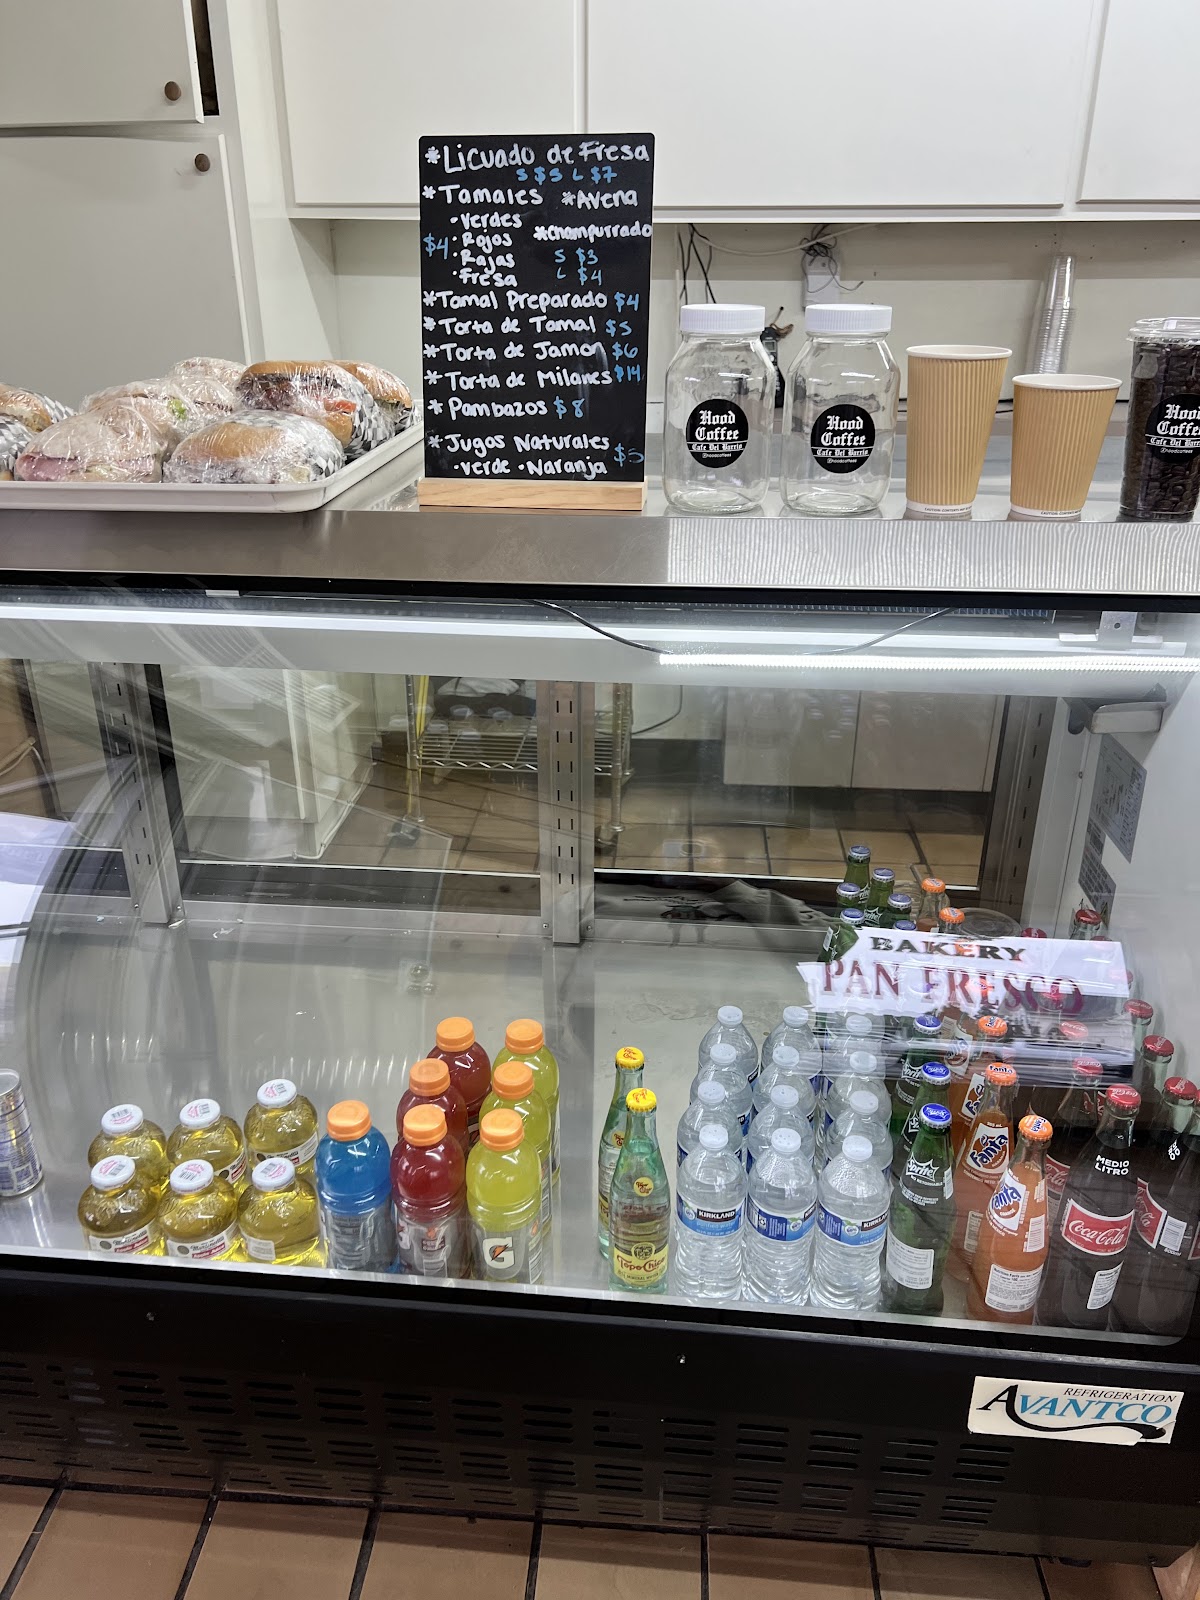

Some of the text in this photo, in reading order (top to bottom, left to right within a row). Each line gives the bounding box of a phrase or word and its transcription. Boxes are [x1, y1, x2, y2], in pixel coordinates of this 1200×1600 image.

[443, 140, 650, 173] Licuado de Fresa
[590, 166, 618, 184] $7
[438, 184, 543, 206] Tamales
[576, 189, 638, 210] Avena
[422, 232, 449, 260] $4
[461, 228, 513, 254] Rojos
[460, 248, 515, 276] Rajas
[575, 247, 599, 266] $3
[577, 265, 602, 286] $4
[436, 289, 640, 313] Tamal Preparado $4
[438, 315, 632, 337] Torta de Tamal $5
[440, 341, 639, 361] Torta de Jamon $6
[444, 371, 500, 391] Torta
[505, 371, 526, 388] de
[448, 396, 548, 420] Pambazos
[699, 410, 736, 425] Hood
[826, 415, 864, 430] Hood
[1156, 420, 1200, 436] Coffe
[513, 434, 610, 451] Naturales
[695, 426, 739, 441] Coffee
[820, 431, 866, 446] Coffee
[613, 442, 645, 467] $5
[526, 456, 608, 480] Naranja
[869, 936, 1027, 962] BAKERY
[823, 960, 1084, 1018] PAN FRESCO
[903, 1064, 921, 1078] Sprit
[989, 1065, 1014, 1074] Fanta
[969, 1134, 1008, 1168] Fanta
[1095, 1154, 1130, 1168] MEDIO
[907, 1159, 935, 1177] Sprite
[1094, 1163, 1129, 1176] LITRO
[698, 1209, 736, 1220] KIRKLAND
[1068, 1219, 1128, 1246] Coca-Cola
[482, 1237, 515, 1269] G
[616, 1254, 667, 1273] Topo Chico
[976, 1384, 1173, 1425] AVANTCO
[1063, 1387, 1178, 1403] REFRIGERATION
